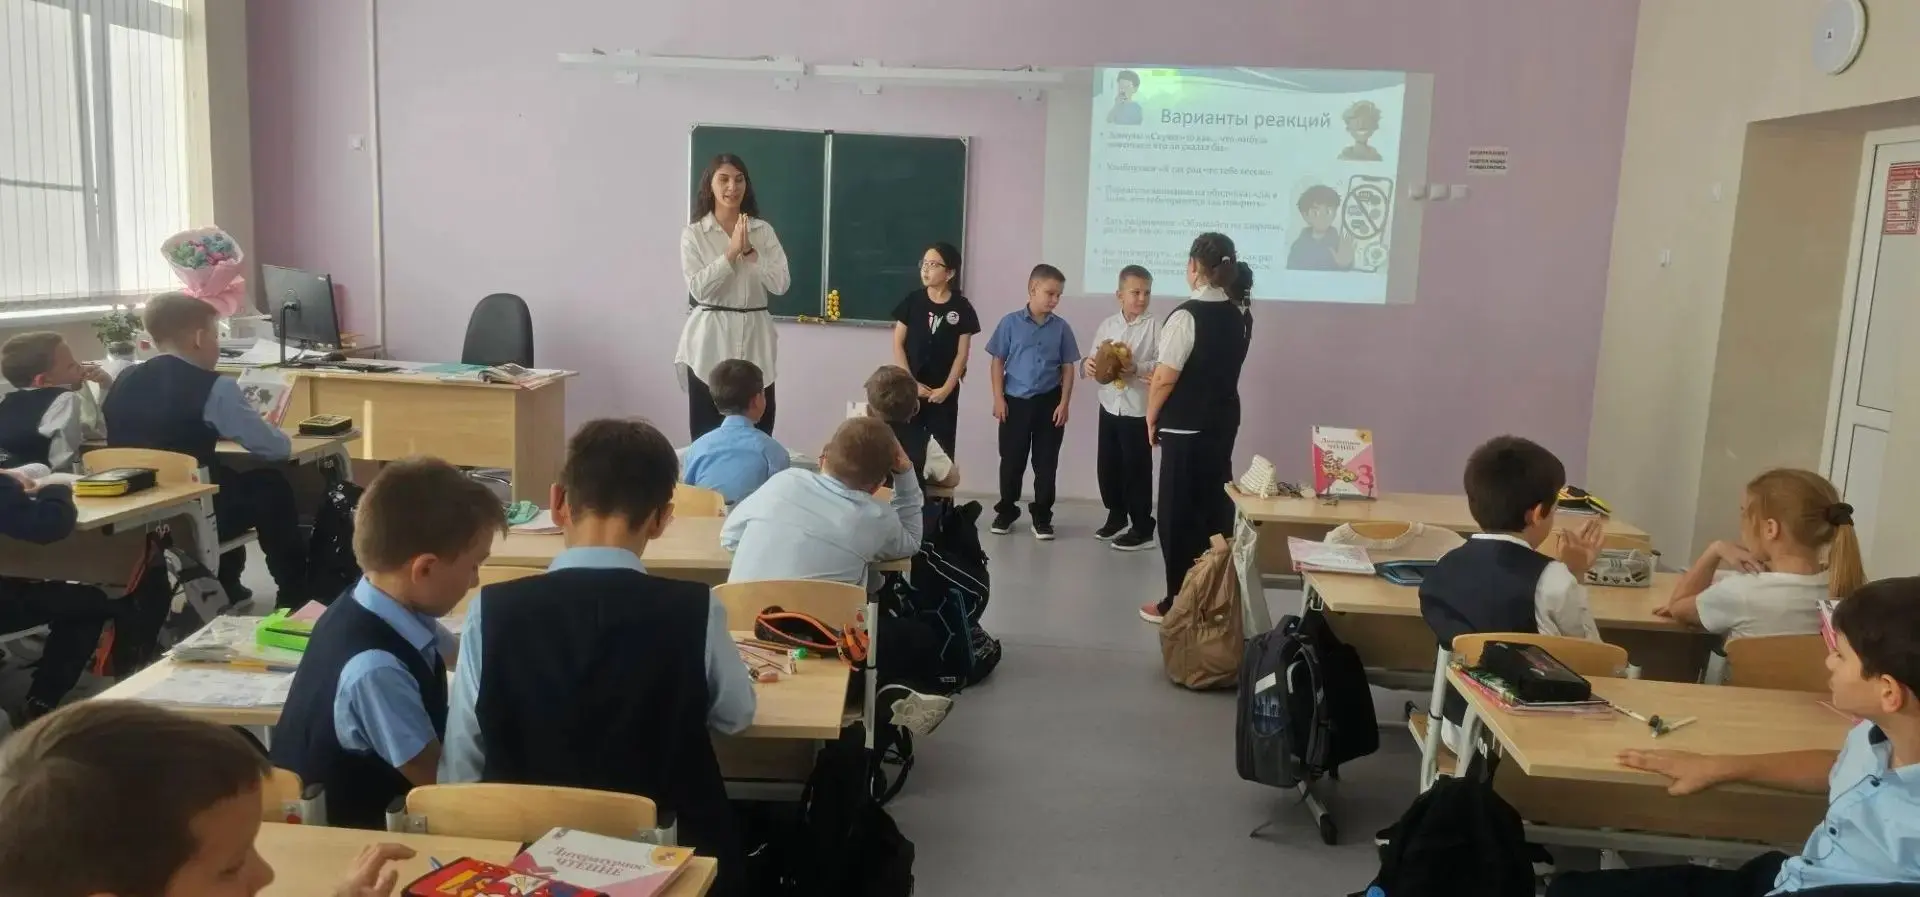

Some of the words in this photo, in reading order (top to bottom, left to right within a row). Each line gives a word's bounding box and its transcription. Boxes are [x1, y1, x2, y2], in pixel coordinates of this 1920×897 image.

[1160, 108, 1249, 128] Варианты
[1254, 112, 1332, 130] реакций
[1358, 464, 1374, 486] 3
[548, 845, 646, 871] Литературное
[556, 857, 624, 877] ЧТЕНИЕ
